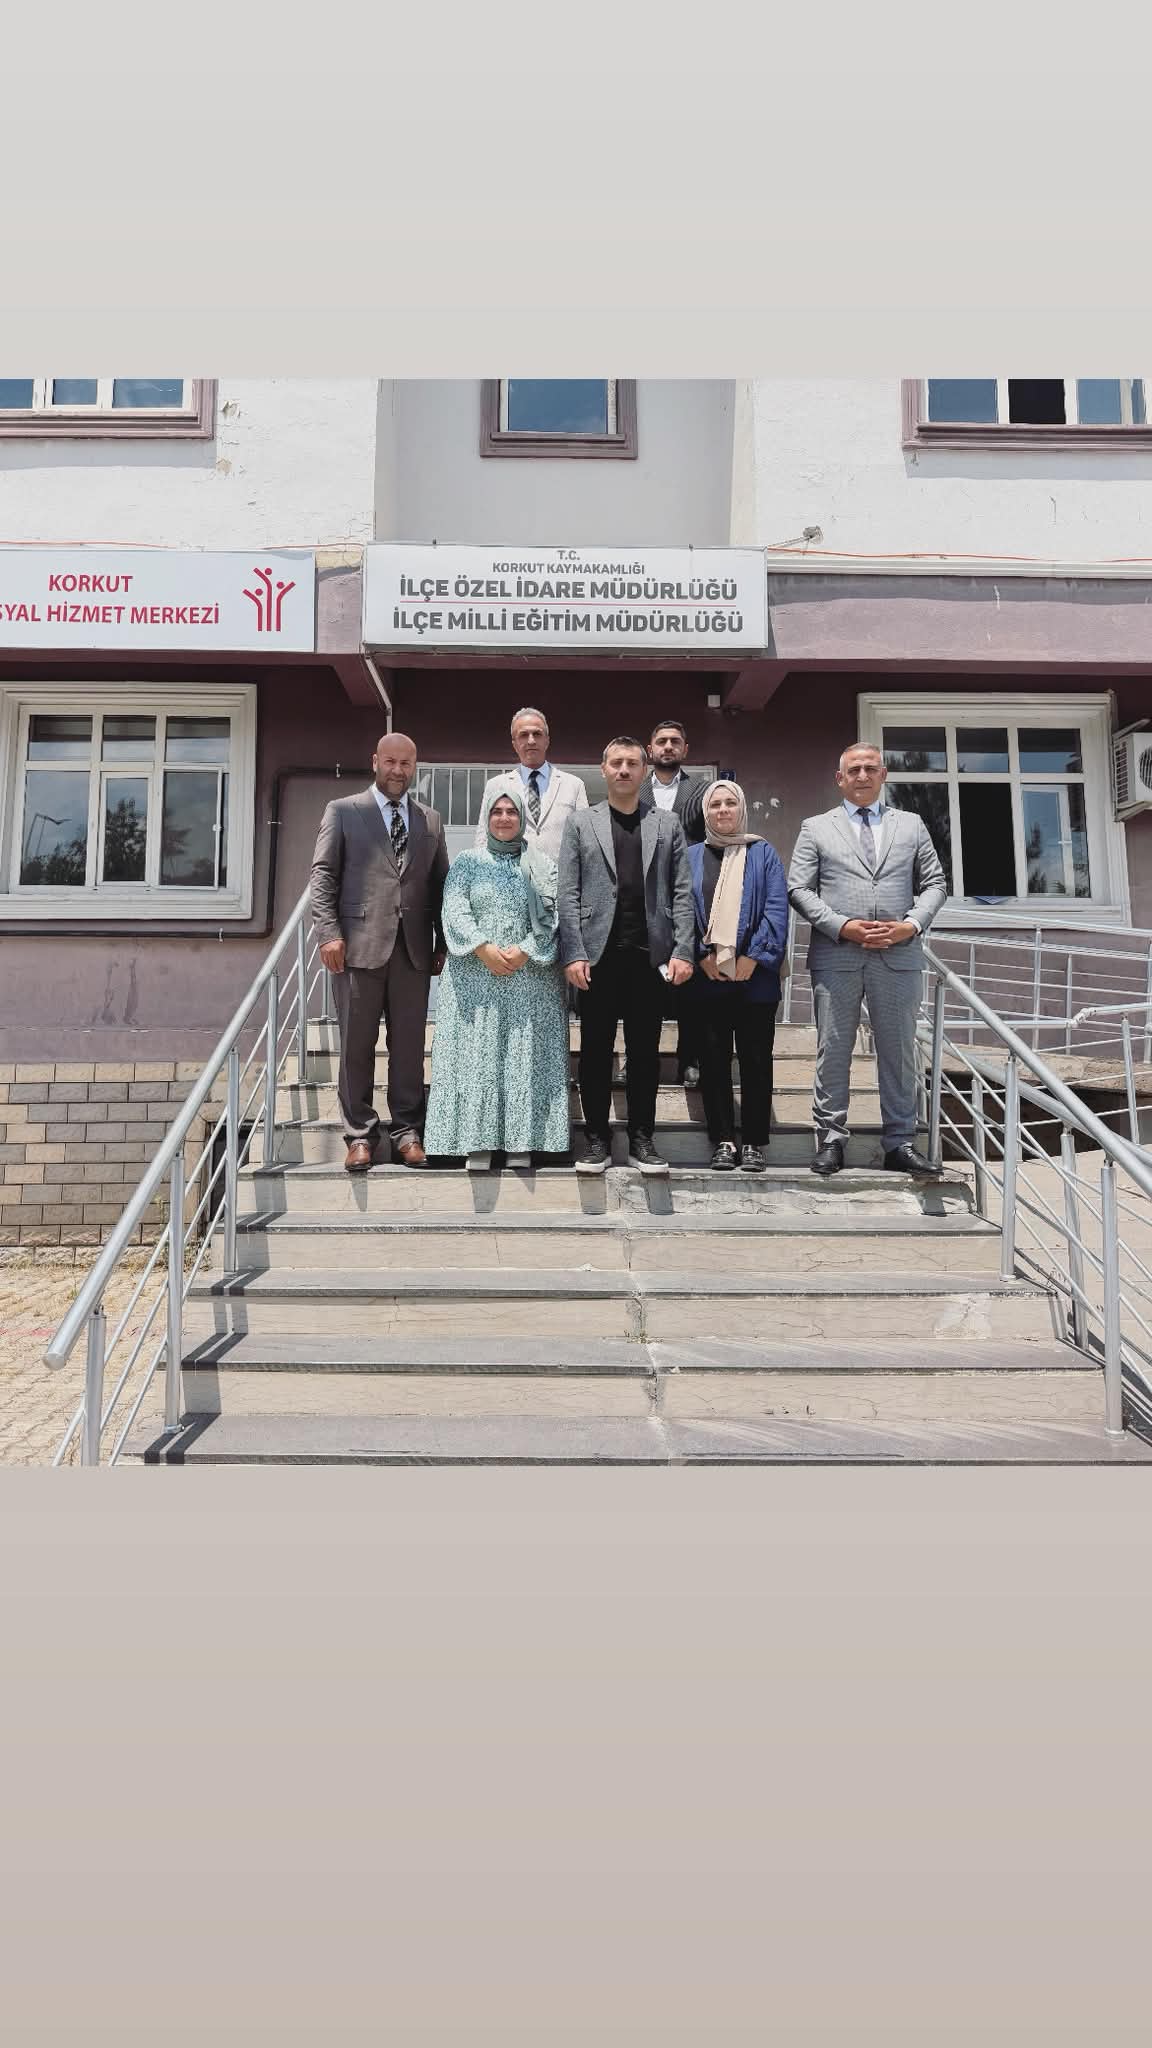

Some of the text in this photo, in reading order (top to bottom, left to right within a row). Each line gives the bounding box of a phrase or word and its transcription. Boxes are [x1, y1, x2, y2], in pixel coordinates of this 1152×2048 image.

[557, 550, 580, 561] T.C.
[493, 562, 645, 575] KORKUT KAYMAKAMLIĞI
[49, 574, 133, 593] KORKUT
[400, 574, 737, 602] İLÇE ÖZEL İDARE MÜDÜRLÜĞÜ
[0, 601, 219, 624] YAL HİZMET MERKEZİ
[393, 606, 743, 635] İLÇE MİLLİ EĞİTİM MÜDÜRLÜĞÜ
